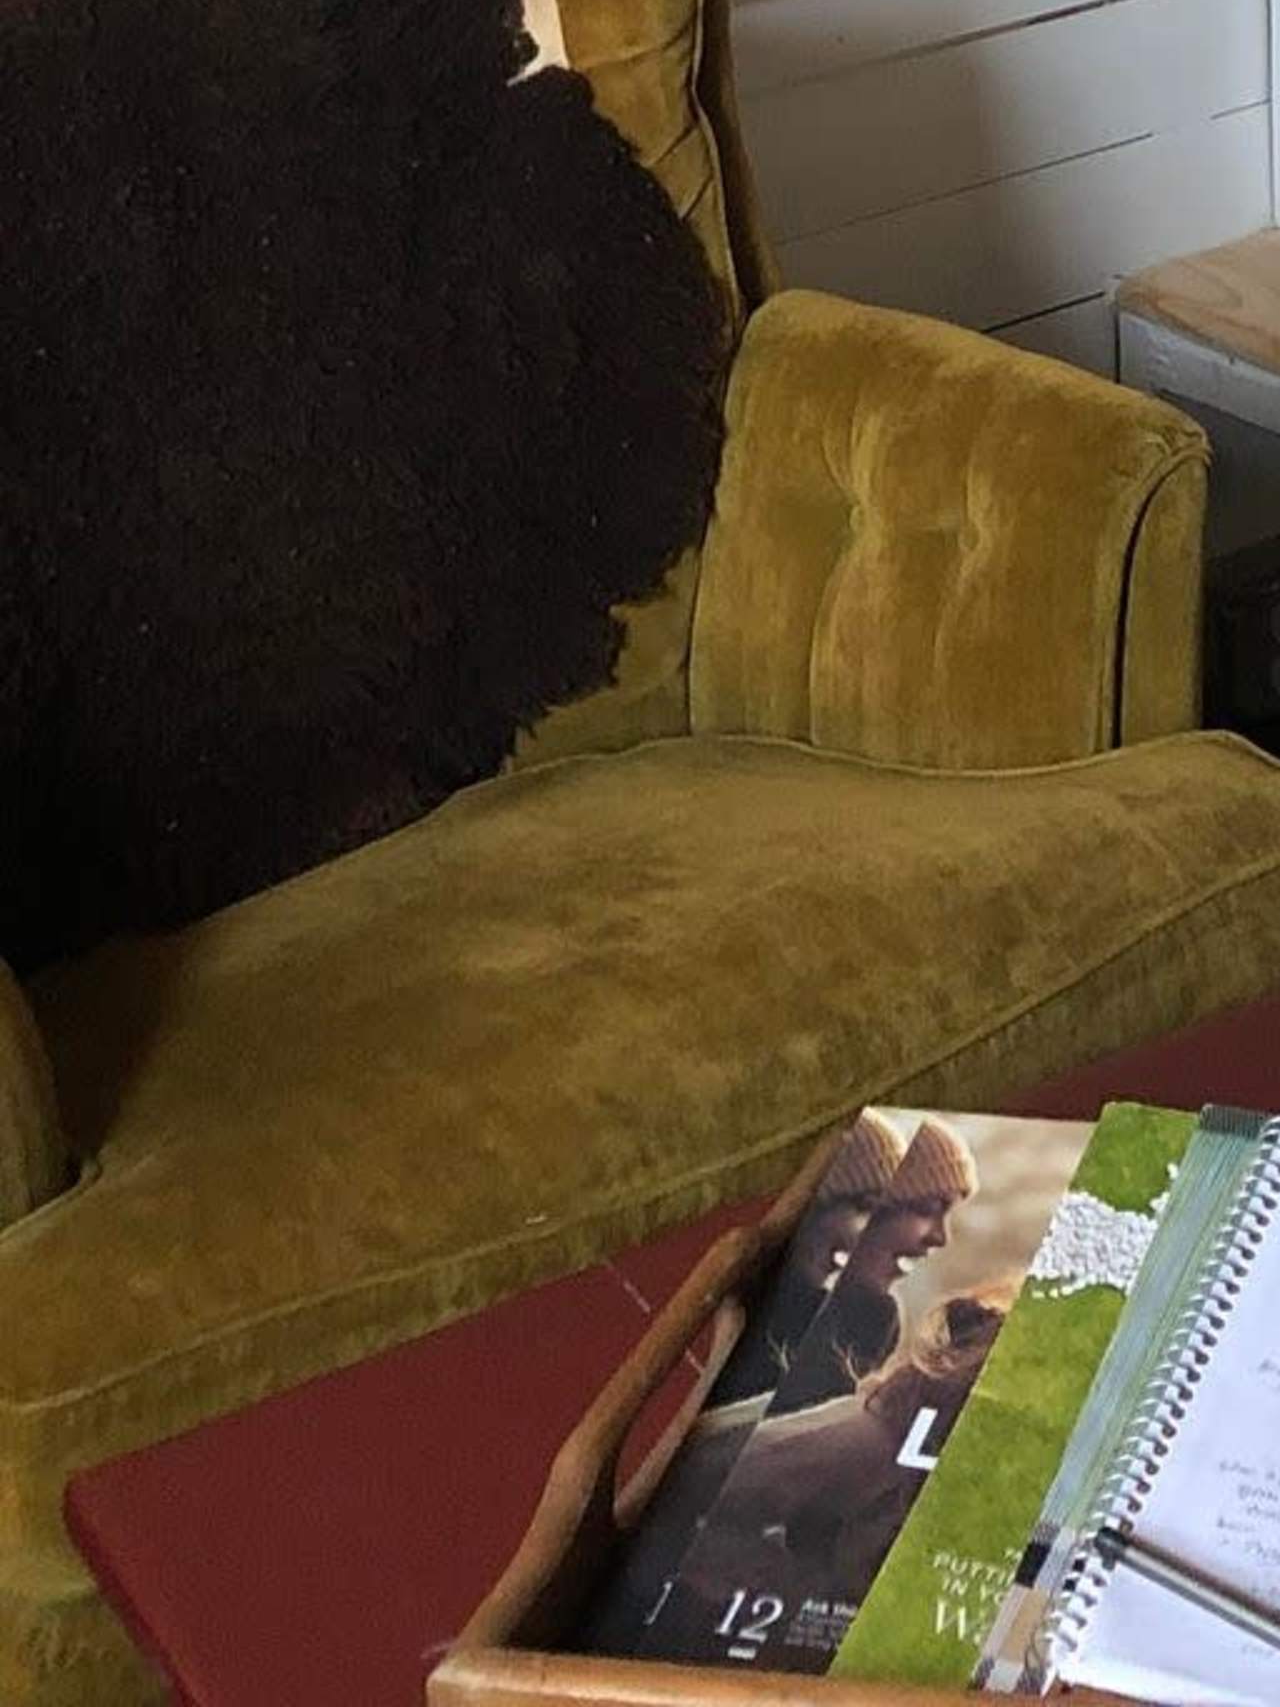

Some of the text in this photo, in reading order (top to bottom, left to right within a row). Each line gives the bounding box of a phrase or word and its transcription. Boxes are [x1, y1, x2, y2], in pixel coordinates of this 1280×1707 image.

[896, 1406, 940, 1471] L
[942, 1576, 969, 1595] IN
[714, 1589, 785, 1643] 12
